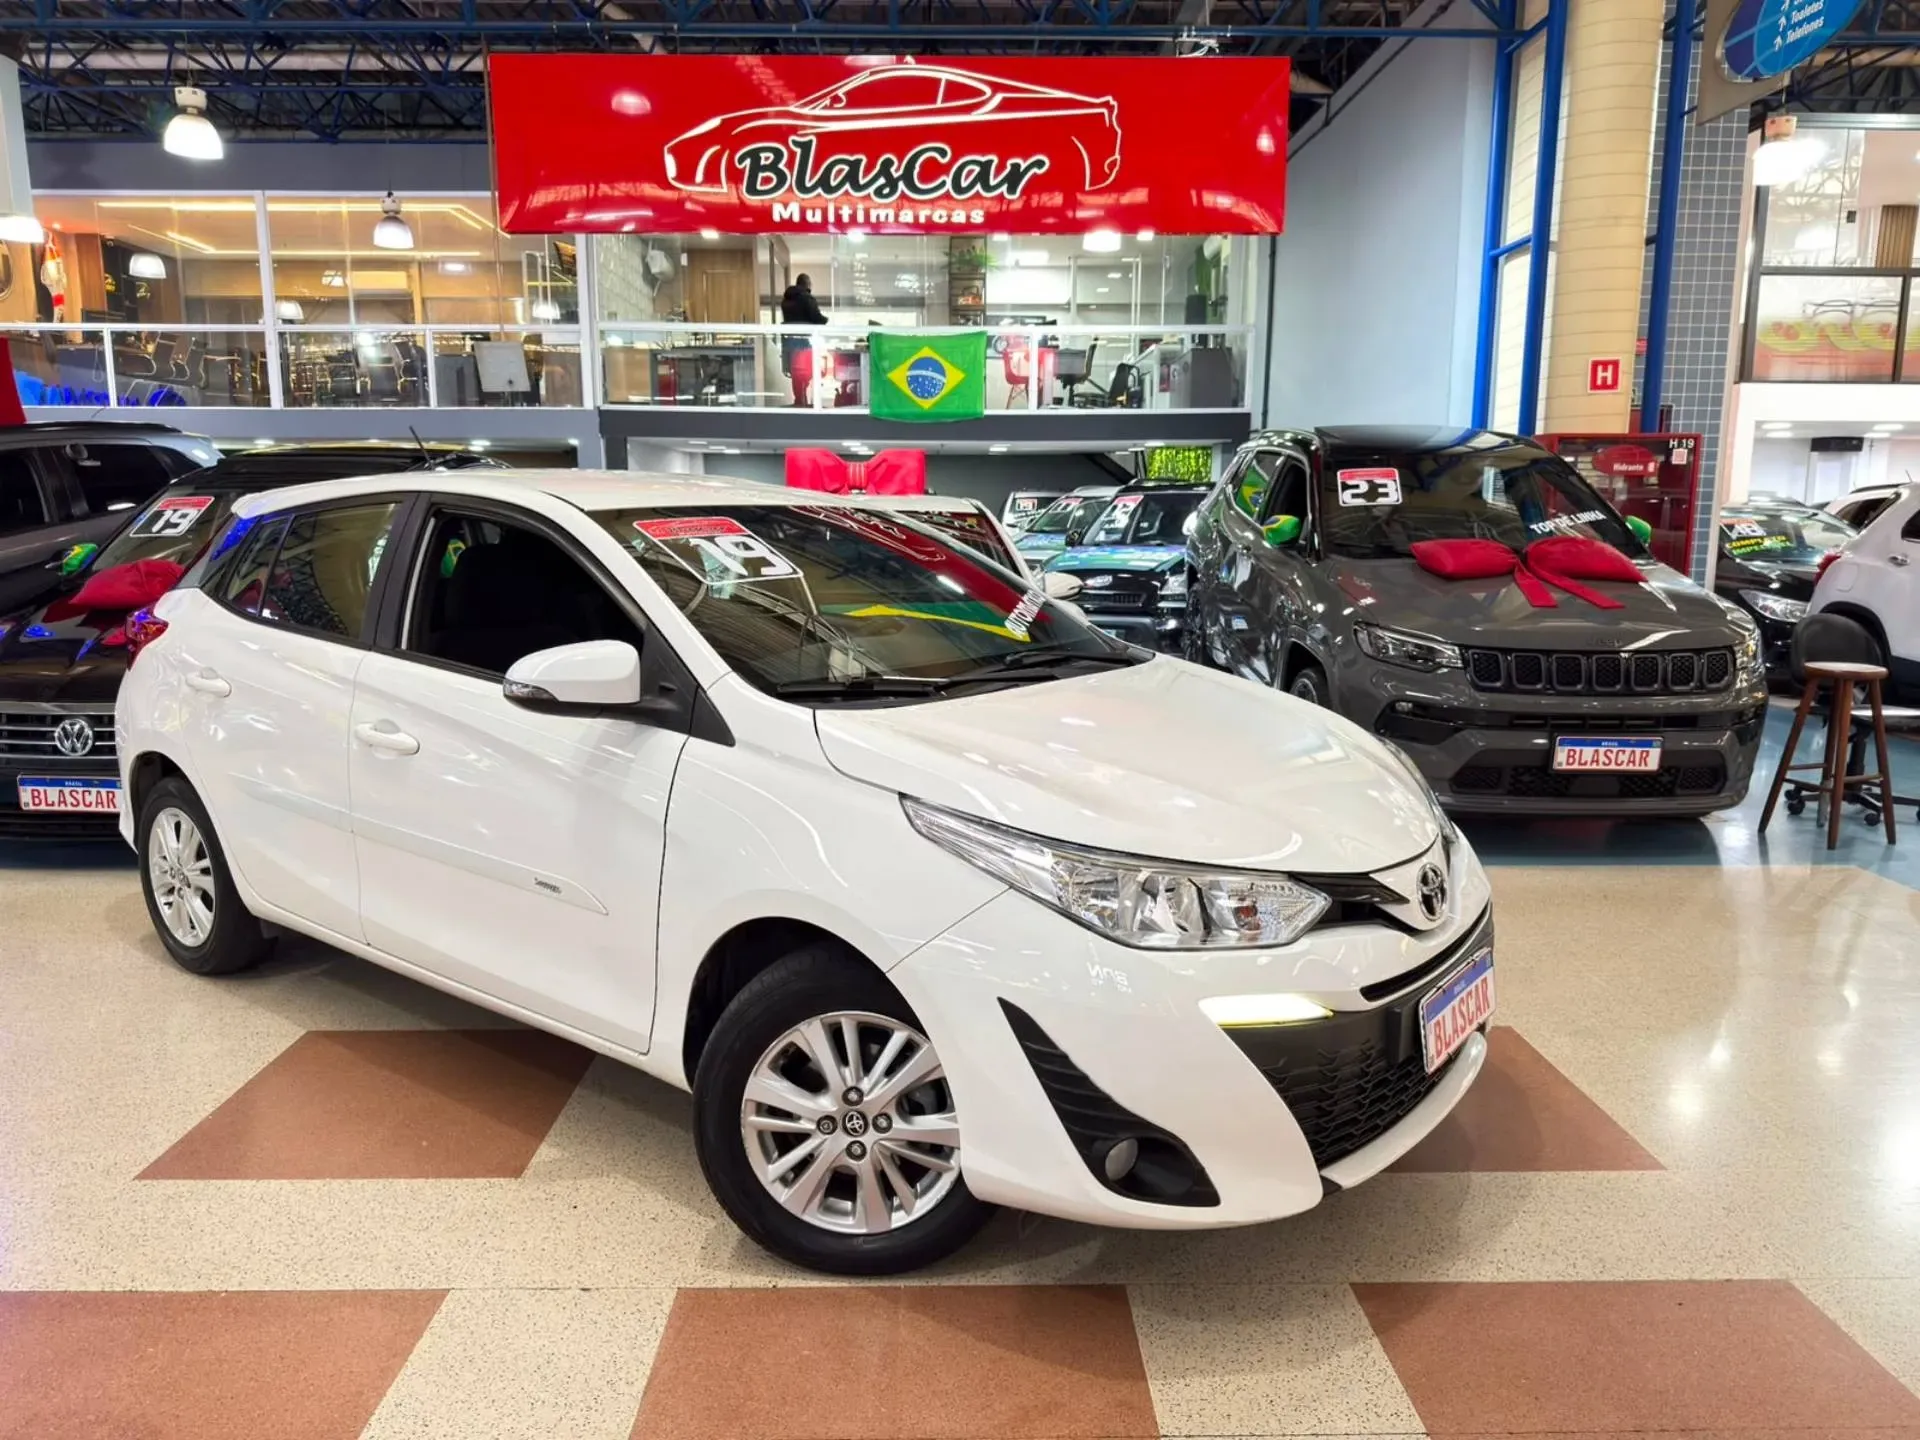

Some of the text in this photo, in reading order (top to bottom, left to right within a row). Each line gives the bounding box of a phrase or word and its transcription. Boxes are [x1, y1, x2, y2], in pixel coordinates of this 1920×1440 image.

[1791, 1, 1823, 24] Toaletes
[1786, 16, 1824, 43] Telefones
[736, 135, 1050, 203] BlasCar
[771, 202, 985, 224] Multimarcas
[1596, 364, 1613, 386] H
[1668, 438, 1695, 449] H 19
[1612, 462, 1644, 472] Hidrante
[1342, 480, 1398, 504] 23
[151, 509, 199, 534] 19
[1529, 520, 1558, 535] TOP
[1570, 509, 1607, 524] LINHA
[689, 535, 794, 577] 19
[1565, 748, 1650, 767] BLASCAR
[30, 788, 117, 809] BLASCAR
[1433, 976, 1490, 1060] BLASCAR
